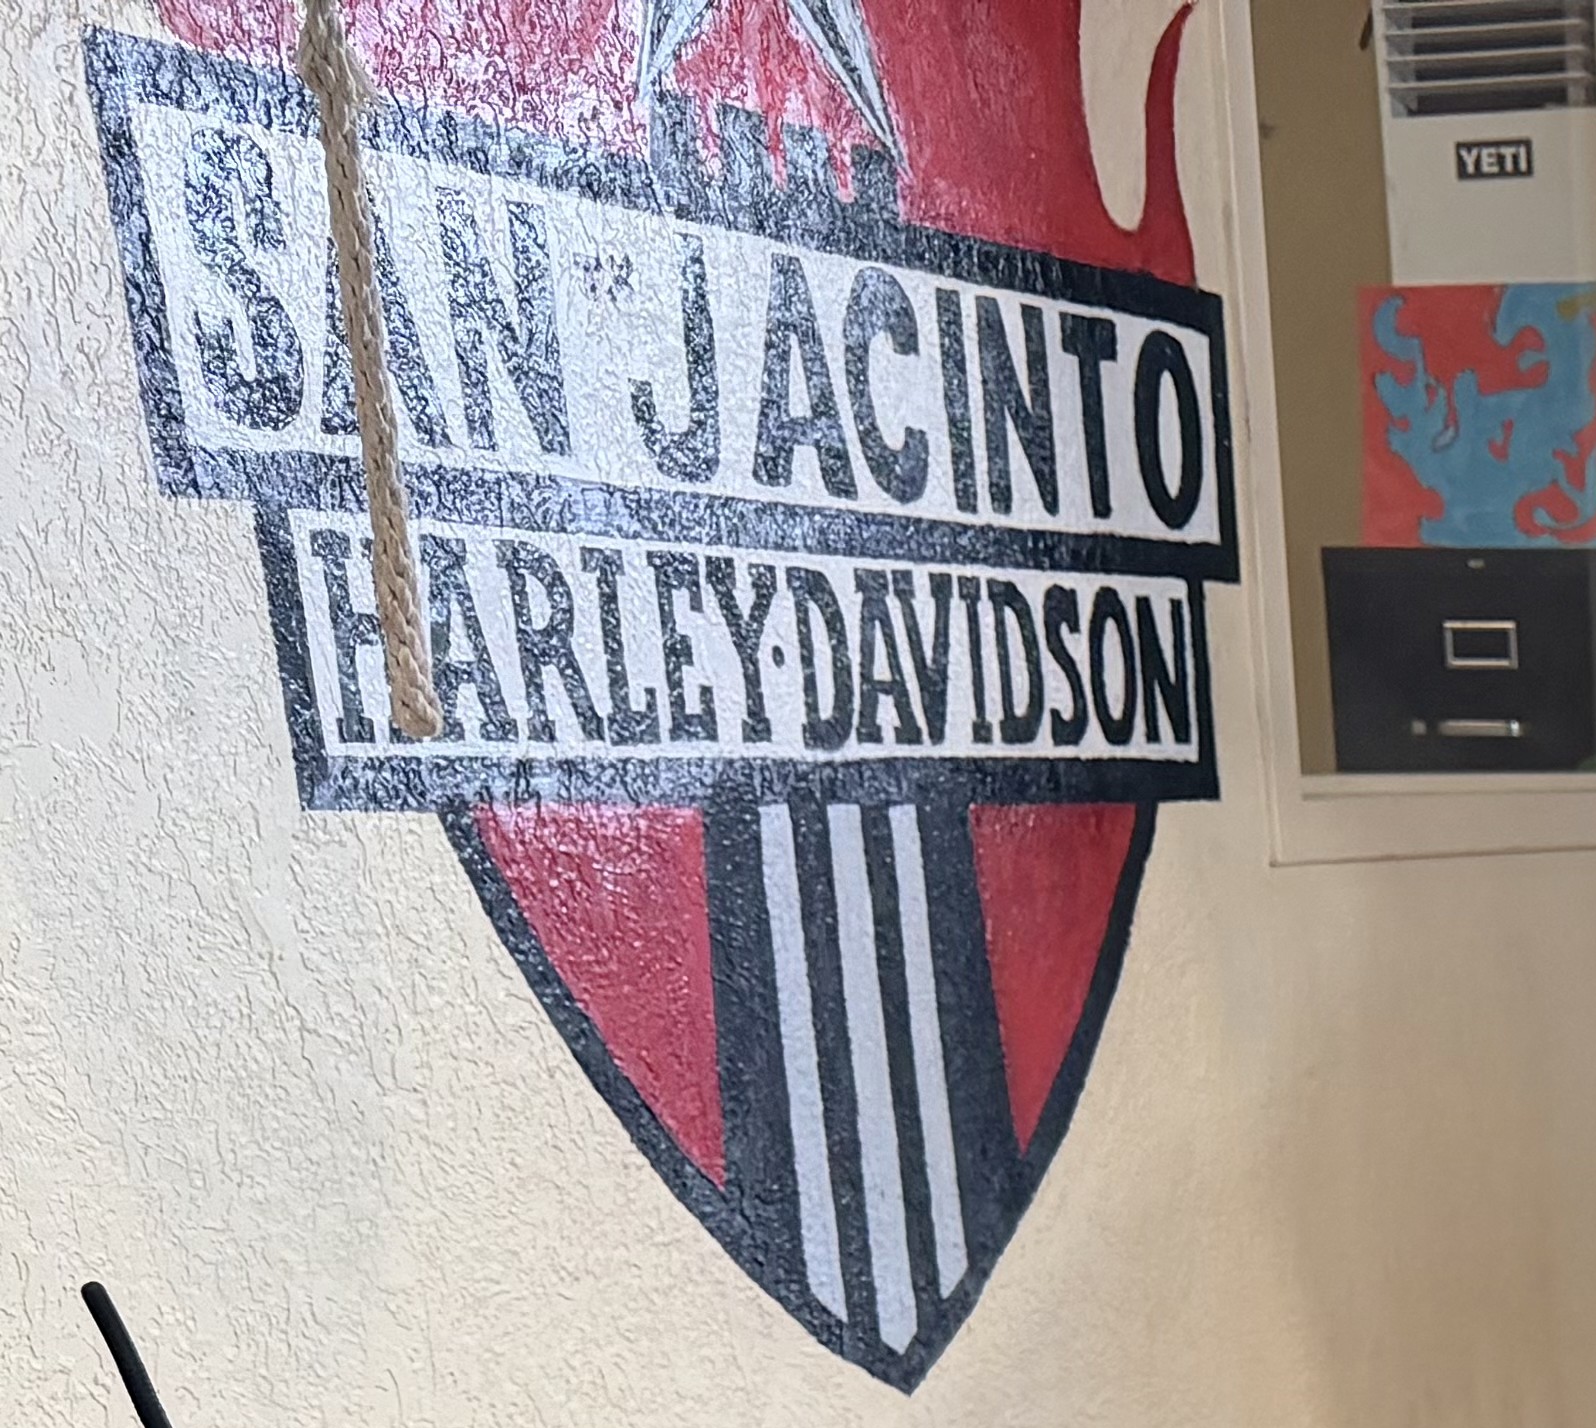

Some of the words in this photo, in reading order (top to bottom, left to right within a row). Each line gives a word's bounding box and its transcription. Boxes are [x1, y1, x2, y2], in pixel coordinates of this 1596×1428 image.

[1459, 144, 1528, 175] YETI
[184, 120, 574, 458] SAN
[628, 230, 1203, 531] JACINTO
